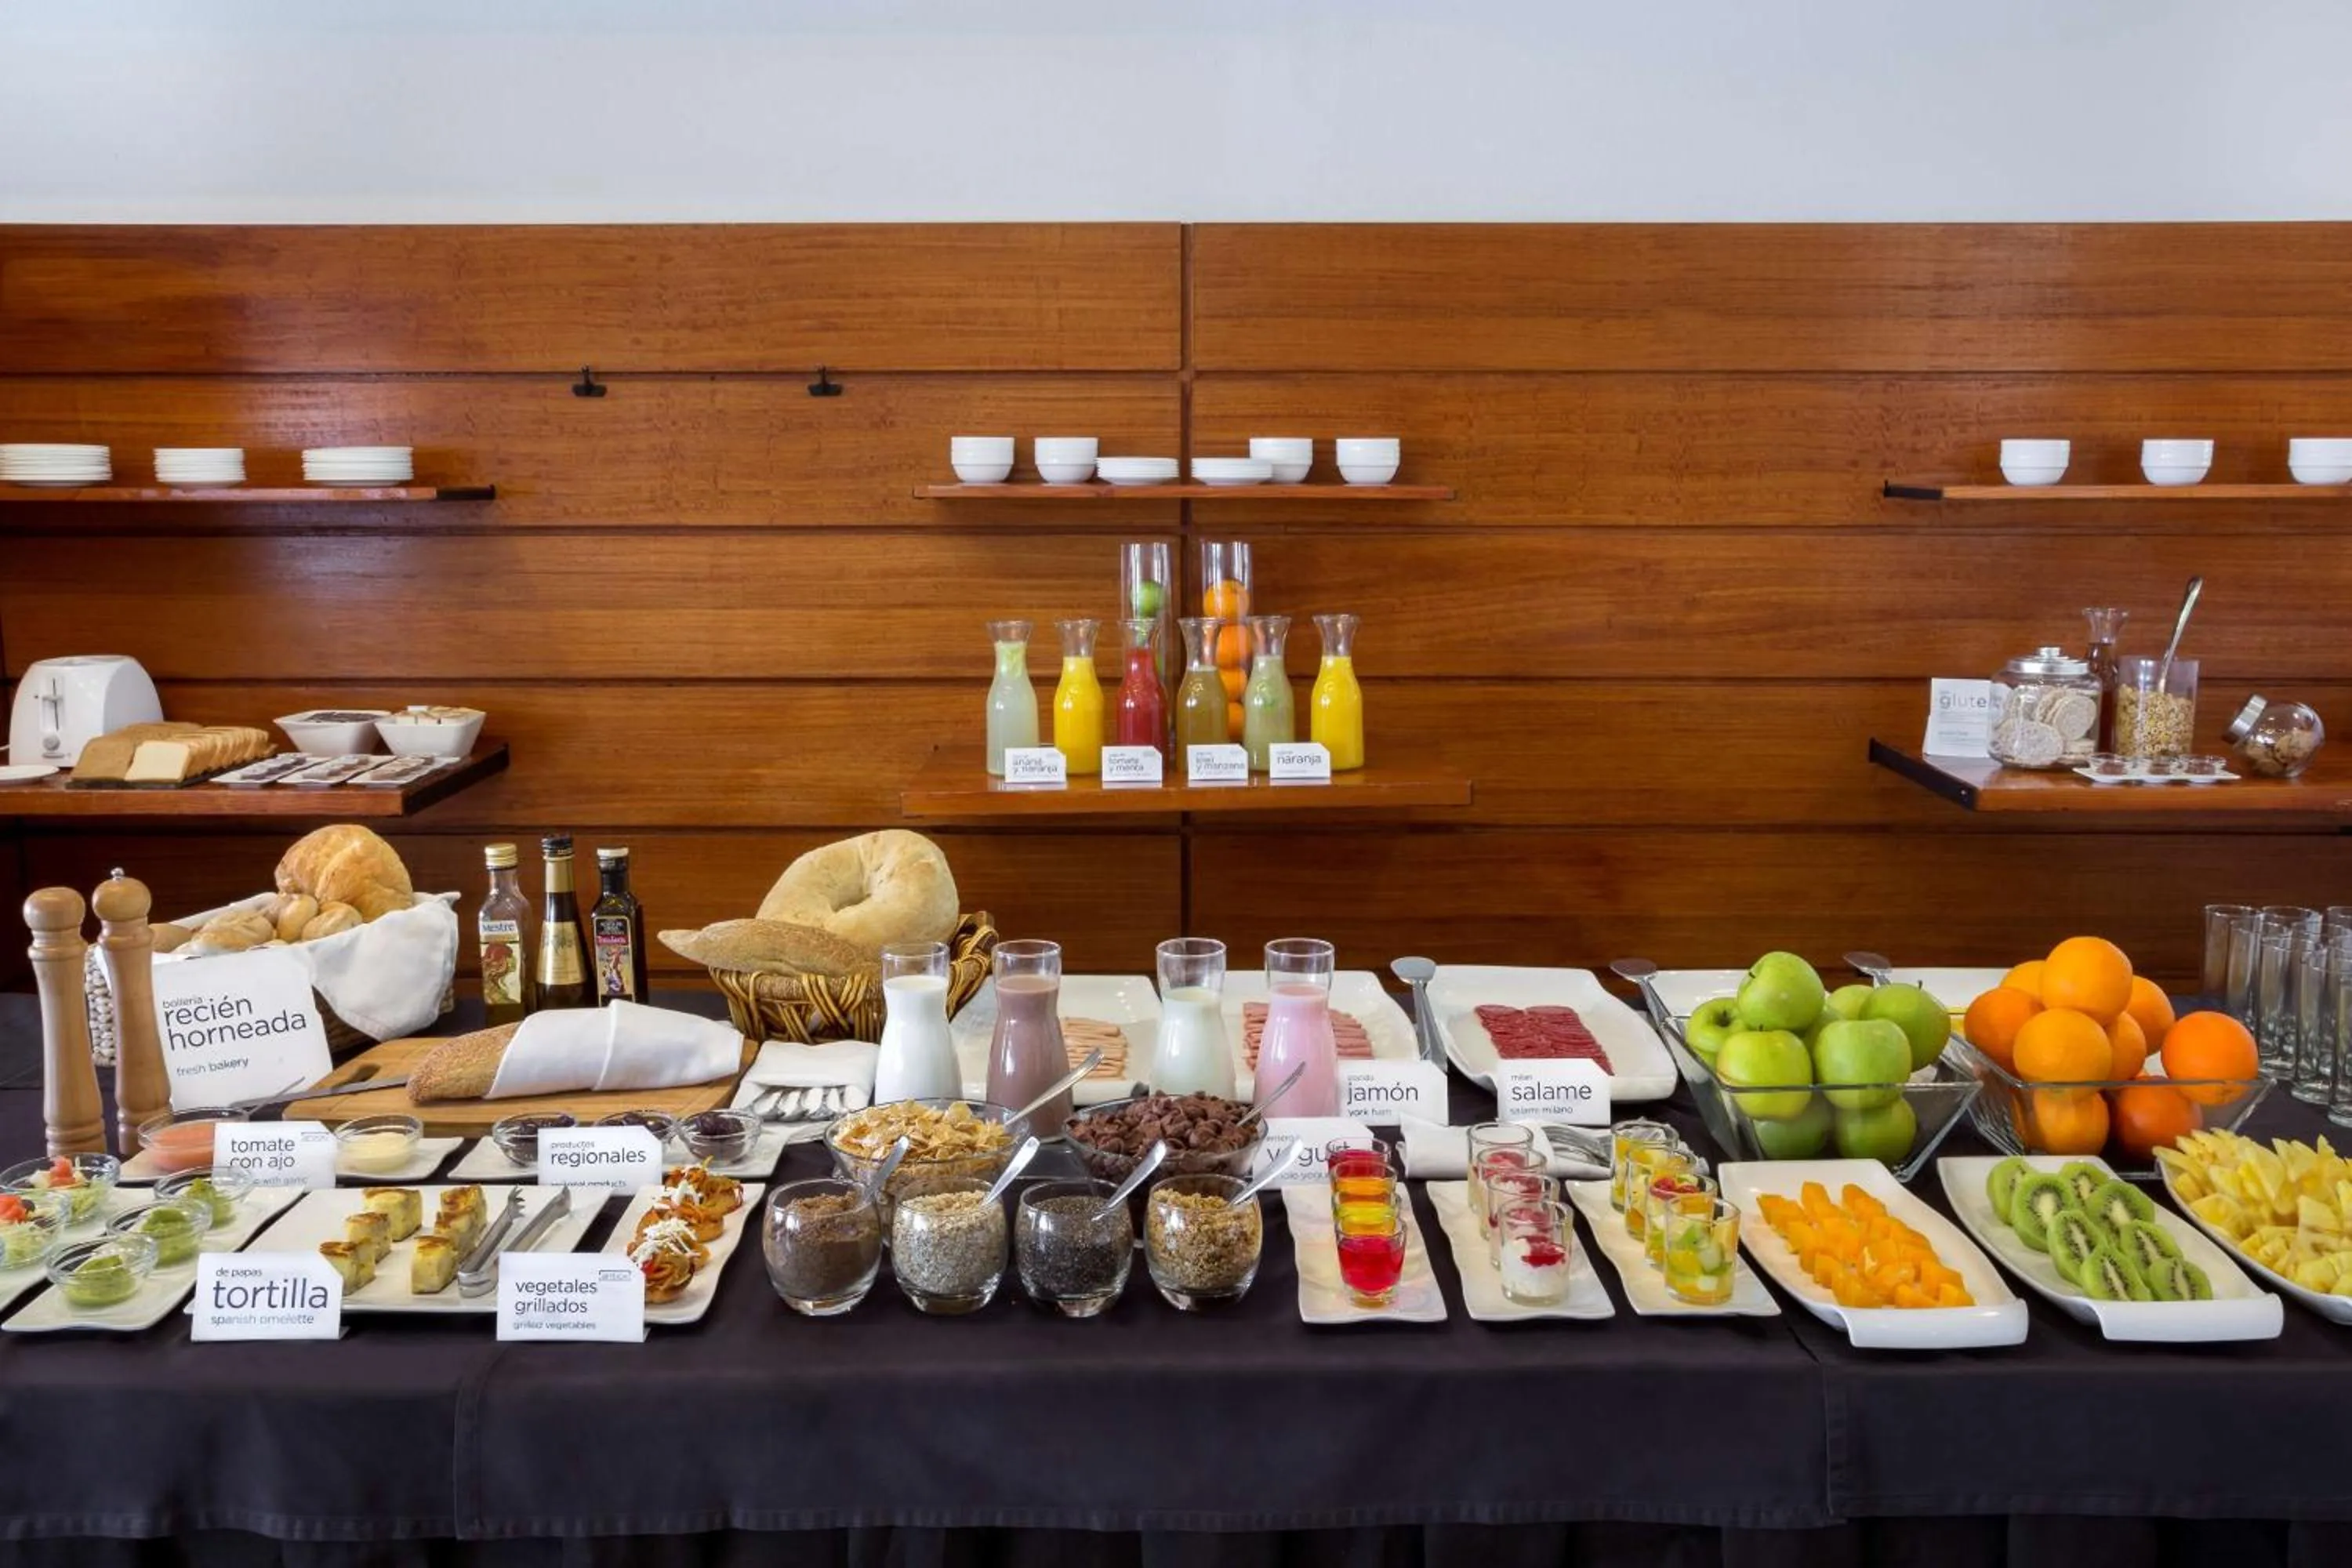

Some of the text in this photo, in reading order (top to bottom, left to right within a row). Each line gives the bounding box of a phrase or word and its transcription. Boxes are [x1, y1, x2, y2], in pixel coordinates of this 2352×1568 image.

[1277, 754, 1322, 766] naranja
[164, 995, 253, 1027] recién
[167, 1009, 307, 1051] horneada
[176, 1057, 249, 1077] fresh bakery
[1347, 1082, 1418, 1105] jamón
[1512, 1081, 1592, 1102] salame
[230, 1138, 296, 1153] tomate
[267, 1152, 296, 1171] ajo
[551, 1148, 647, 1167] regionales
[216, 1267, 263, 1277] de papas
[212, 1277, 328, 1308] tortilla
[514, 1279, 598, 1296] vegetales
[514, 1298, 589, 1316] grillados
[211, 1313, 314, 1327] spanish omelette
[546, 1320, 596, 1330] vegetables
